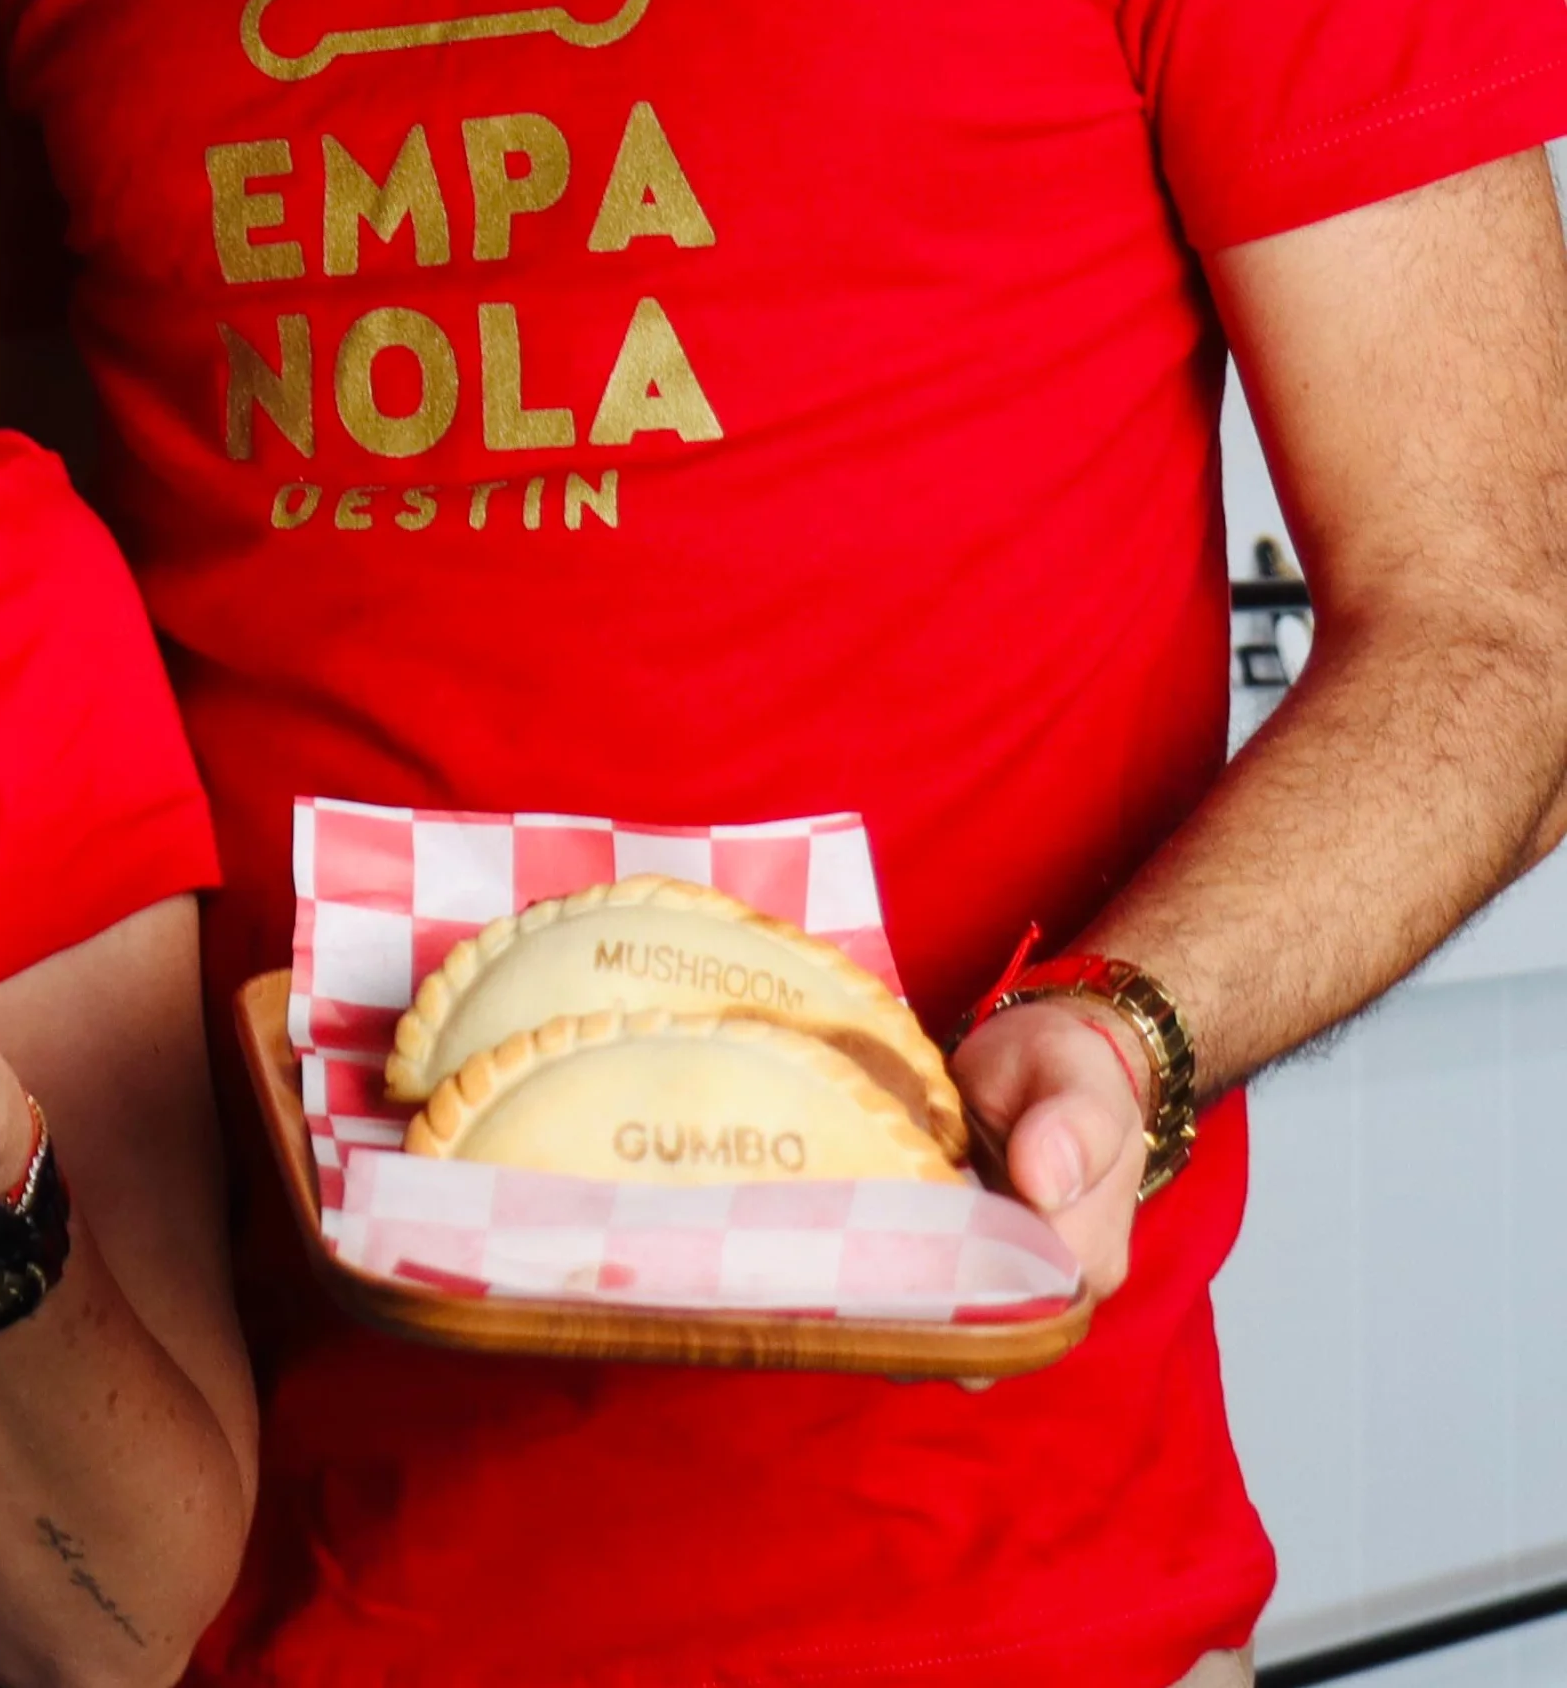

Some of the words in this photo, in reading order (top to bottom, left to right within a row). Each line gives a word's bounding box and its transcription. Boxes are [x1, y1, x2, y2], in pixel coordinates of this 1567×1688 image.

[205, 101, 716, 284] EMPA
[216, 296, 724, 461] NOLA
[270, 469, 619, 531] DESTIN
[593, 939, 806, 1010] MUSHROOM
[612, 1121, 807, 1174] GUMBO
